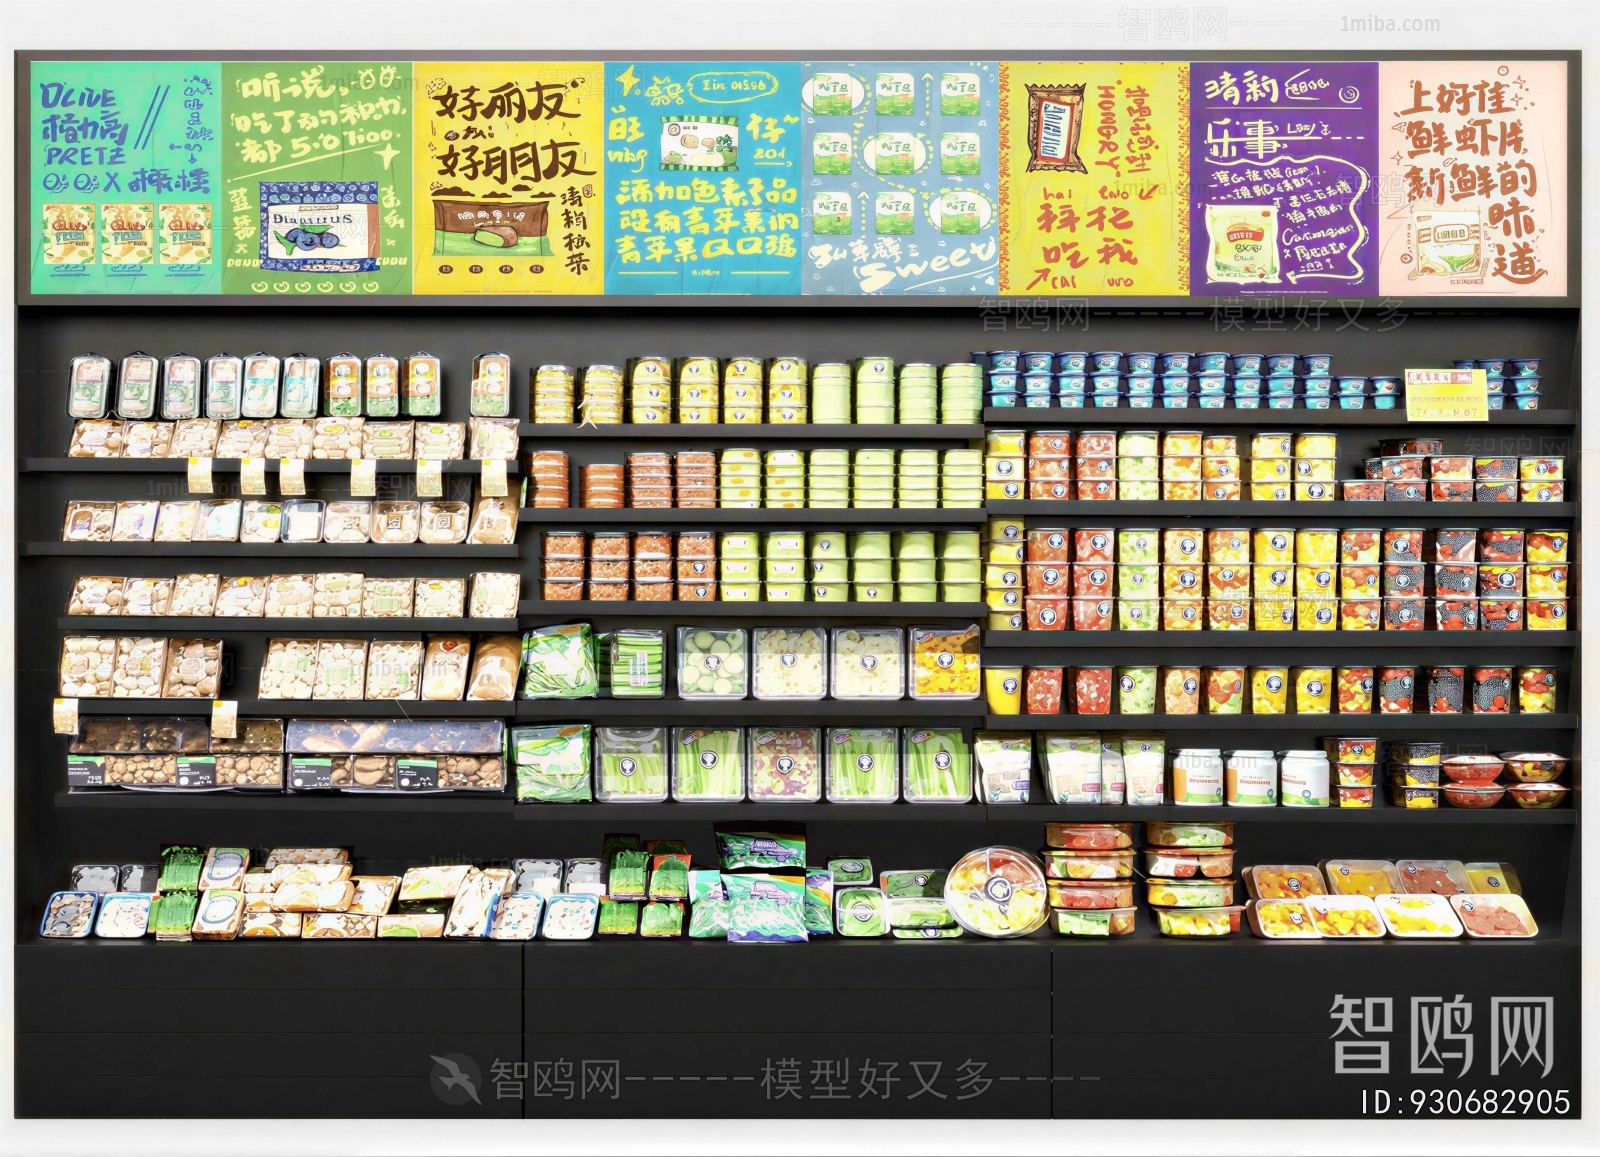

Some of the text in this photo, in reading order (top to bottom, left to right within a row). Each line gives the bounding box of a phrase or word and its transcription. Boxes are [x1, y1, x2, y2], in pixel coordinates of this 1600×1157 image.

[431, 80, 581, 124] 好丽友
[1399, 79, 1516, 116] 上好佳
